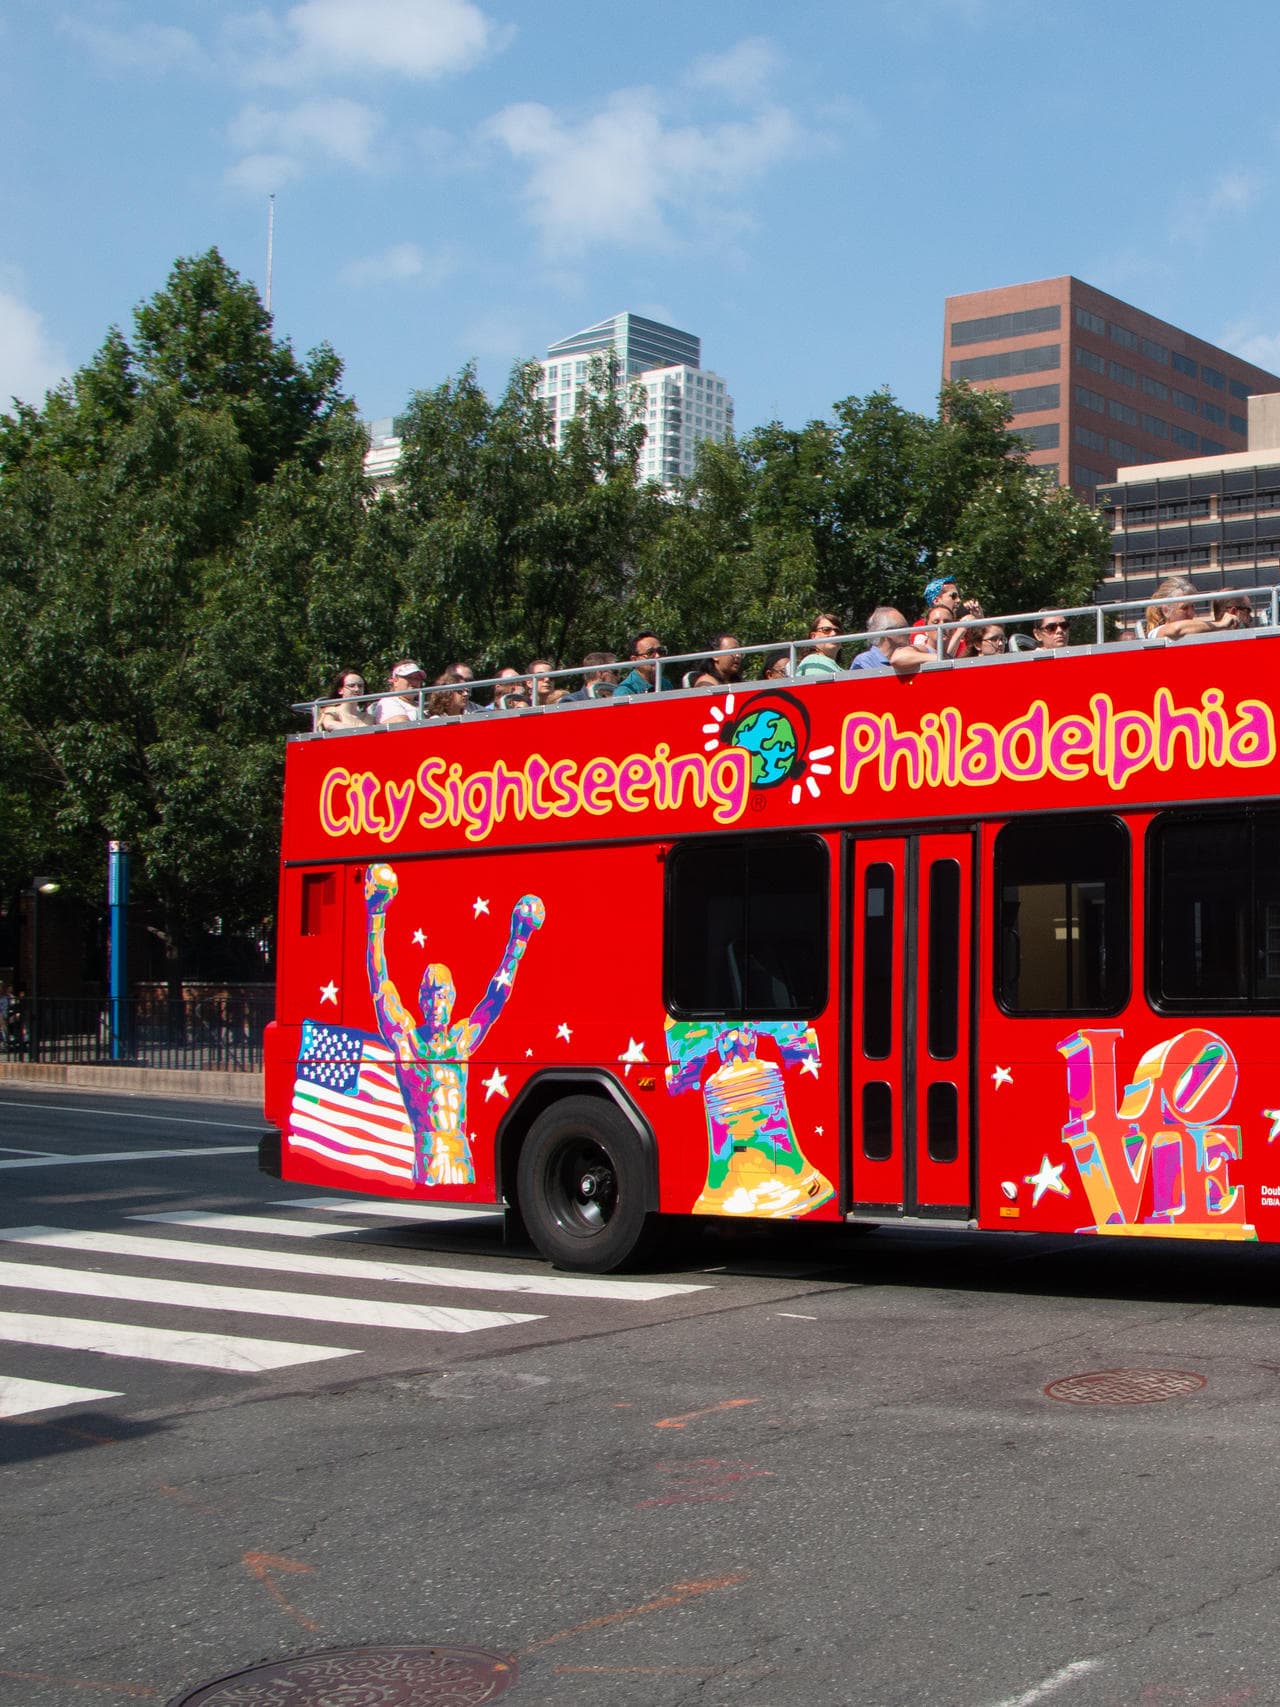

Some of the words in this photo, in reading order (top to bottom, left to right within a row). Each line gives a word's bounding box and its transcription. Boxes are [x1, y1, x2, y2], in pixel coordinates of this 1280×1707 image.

[320, 767, 416, 842] City
[416, 743, 752, 842] Sightseeing
[840, 686, 1276, 796] Philadelphia
[1261, 1197, 1280, 1206] D/B/A
